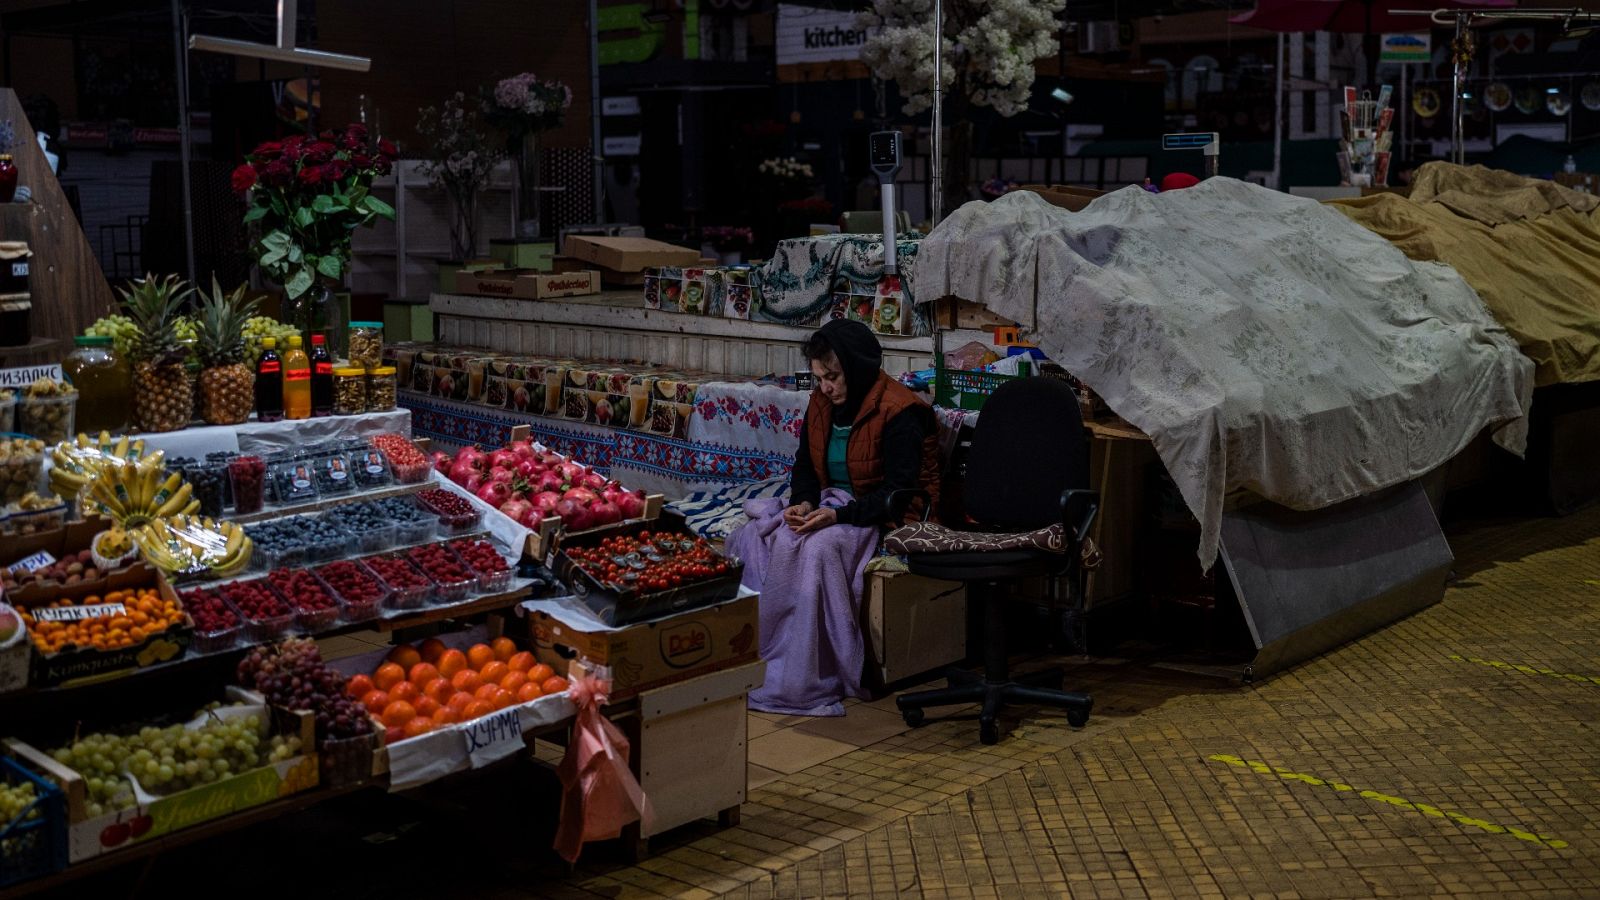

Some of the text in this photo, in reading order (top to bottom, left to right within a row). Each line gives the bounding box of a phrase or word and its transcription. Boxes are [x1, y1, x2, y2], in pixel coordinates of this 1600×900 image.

[805, 26, 866, 48] kitchen
[669, 630, 706, 653] Dole
[465, 709, 522, 753] ХУРМА
